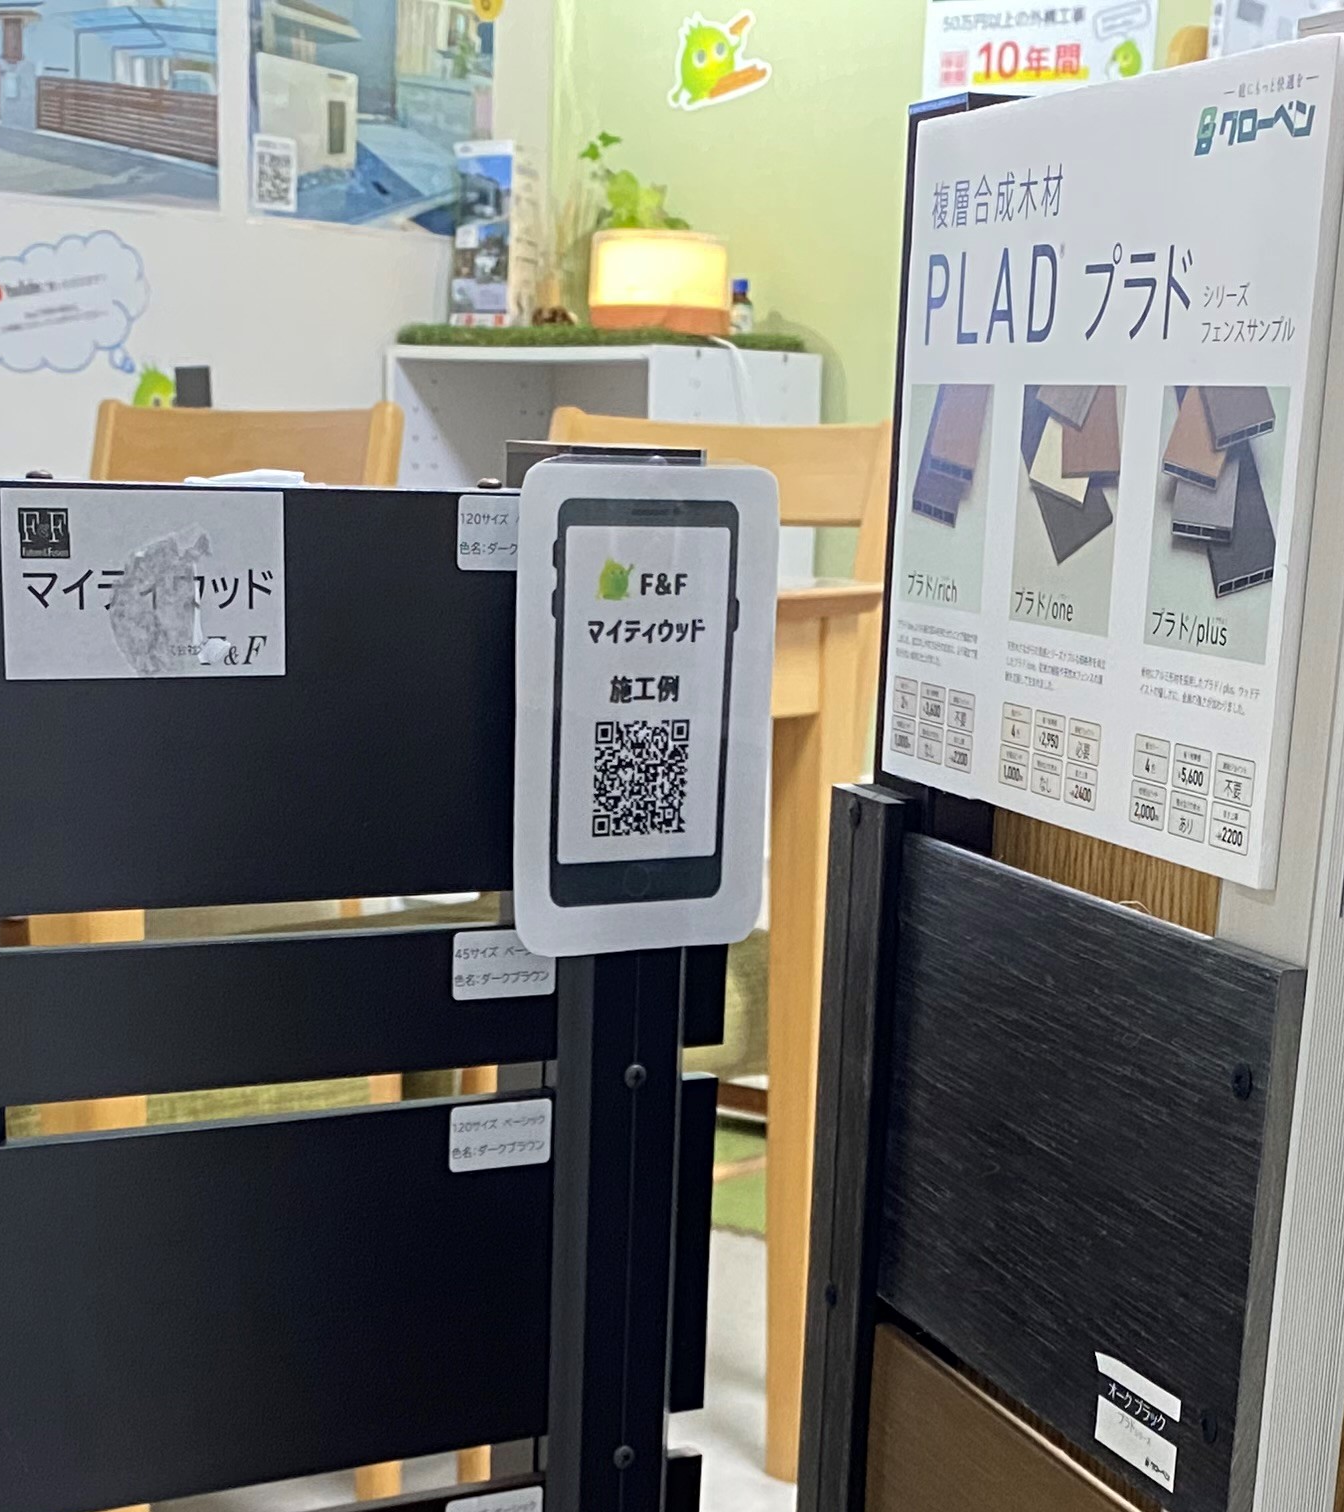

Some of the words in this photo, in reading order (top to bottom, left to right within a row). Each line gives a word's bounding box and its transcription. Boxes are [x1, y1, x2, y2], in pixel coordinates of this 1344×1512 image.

[978, 41, 1082, 79] 10年間
[1219, 100, 1316, 146] グローベン
[931, 164, 1064, 230] 複層合成木材
[1084, 243, 1194, 342] プラド
[1202, 282, 1250, 309] シリーズ
[1201, 316, 1296, 344] フェンスサンプル
[460, 511, 509, 527] 120サイズ
[640, 573, 688, 596] F&F
[1014, 590, 1074, 623] プラド/one
[588, 619, 706, 644] マイティウッド
[1151, 610, 1228, 647] プラド/plus
[609, 675, 680, 704] 施工例
[1223, 779, 1243, 801] 不要
[1178, 817, 1194, 833] あり
